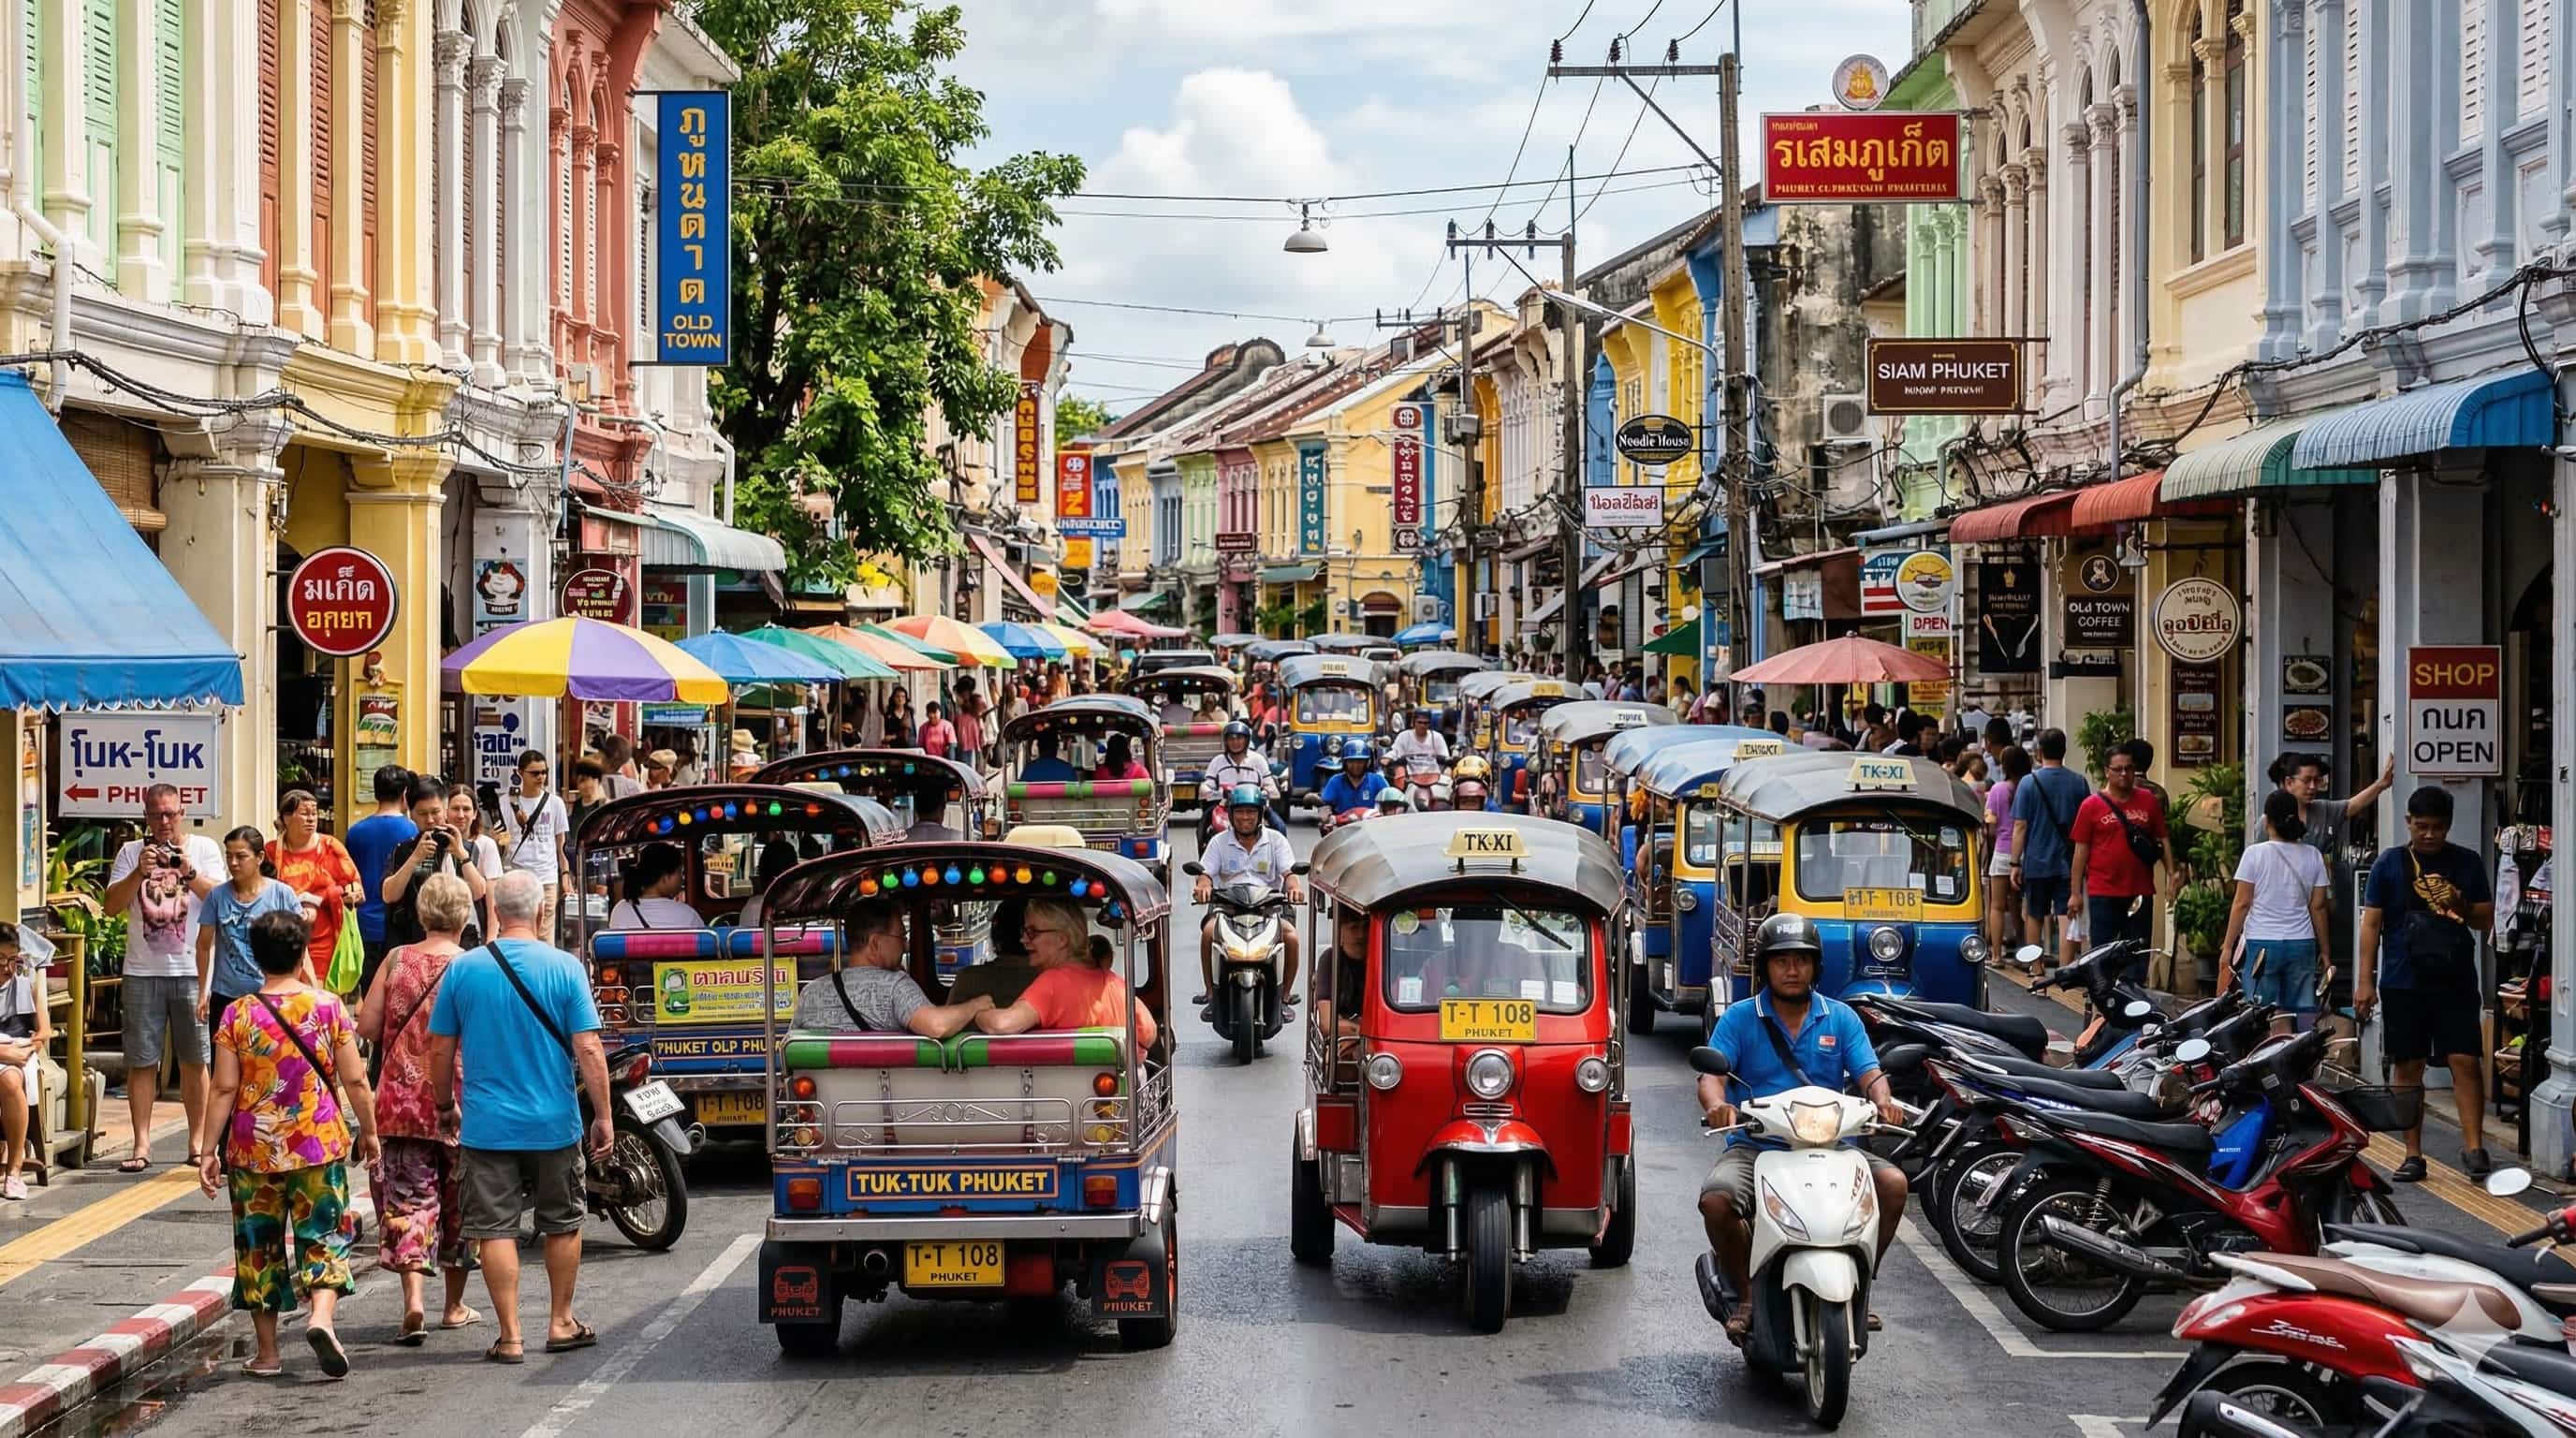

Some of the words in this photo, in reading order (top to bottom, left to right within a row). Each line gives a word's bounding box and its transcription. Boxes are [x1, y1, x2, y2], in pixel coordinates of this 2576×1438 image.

[673, 315, 712, 330] OLD
[664, 333, 721, 348] TOWN
[1878, 362, 1925, 379] SIAM
[1932, 362, 2010, 379] PHUKET
[2096, 602, 2130, 613] TOWN
[2077, 616, 2122, 627] COFFEE
[2415, 663, 2495, 686] SHOP
[2414, 741, 2494, 763] OPEN
[1493, 1003, 1531, 1023] 108
[1465, 1028, 1513, 1038] PHUKET
[657, 1041, 708, 1054] PHUKET
[856, 1172, 953, 1193] TUK-TUK
[960, 1171, 1047, 1192] PHUKET
[959, 1244, 999, 1268] 108
[930, 1271, 978, 1283] PHUKET
[770, 1306, 821, 1317] PHUKET
[1104, 1301, 1153, 1312] PHUKET
